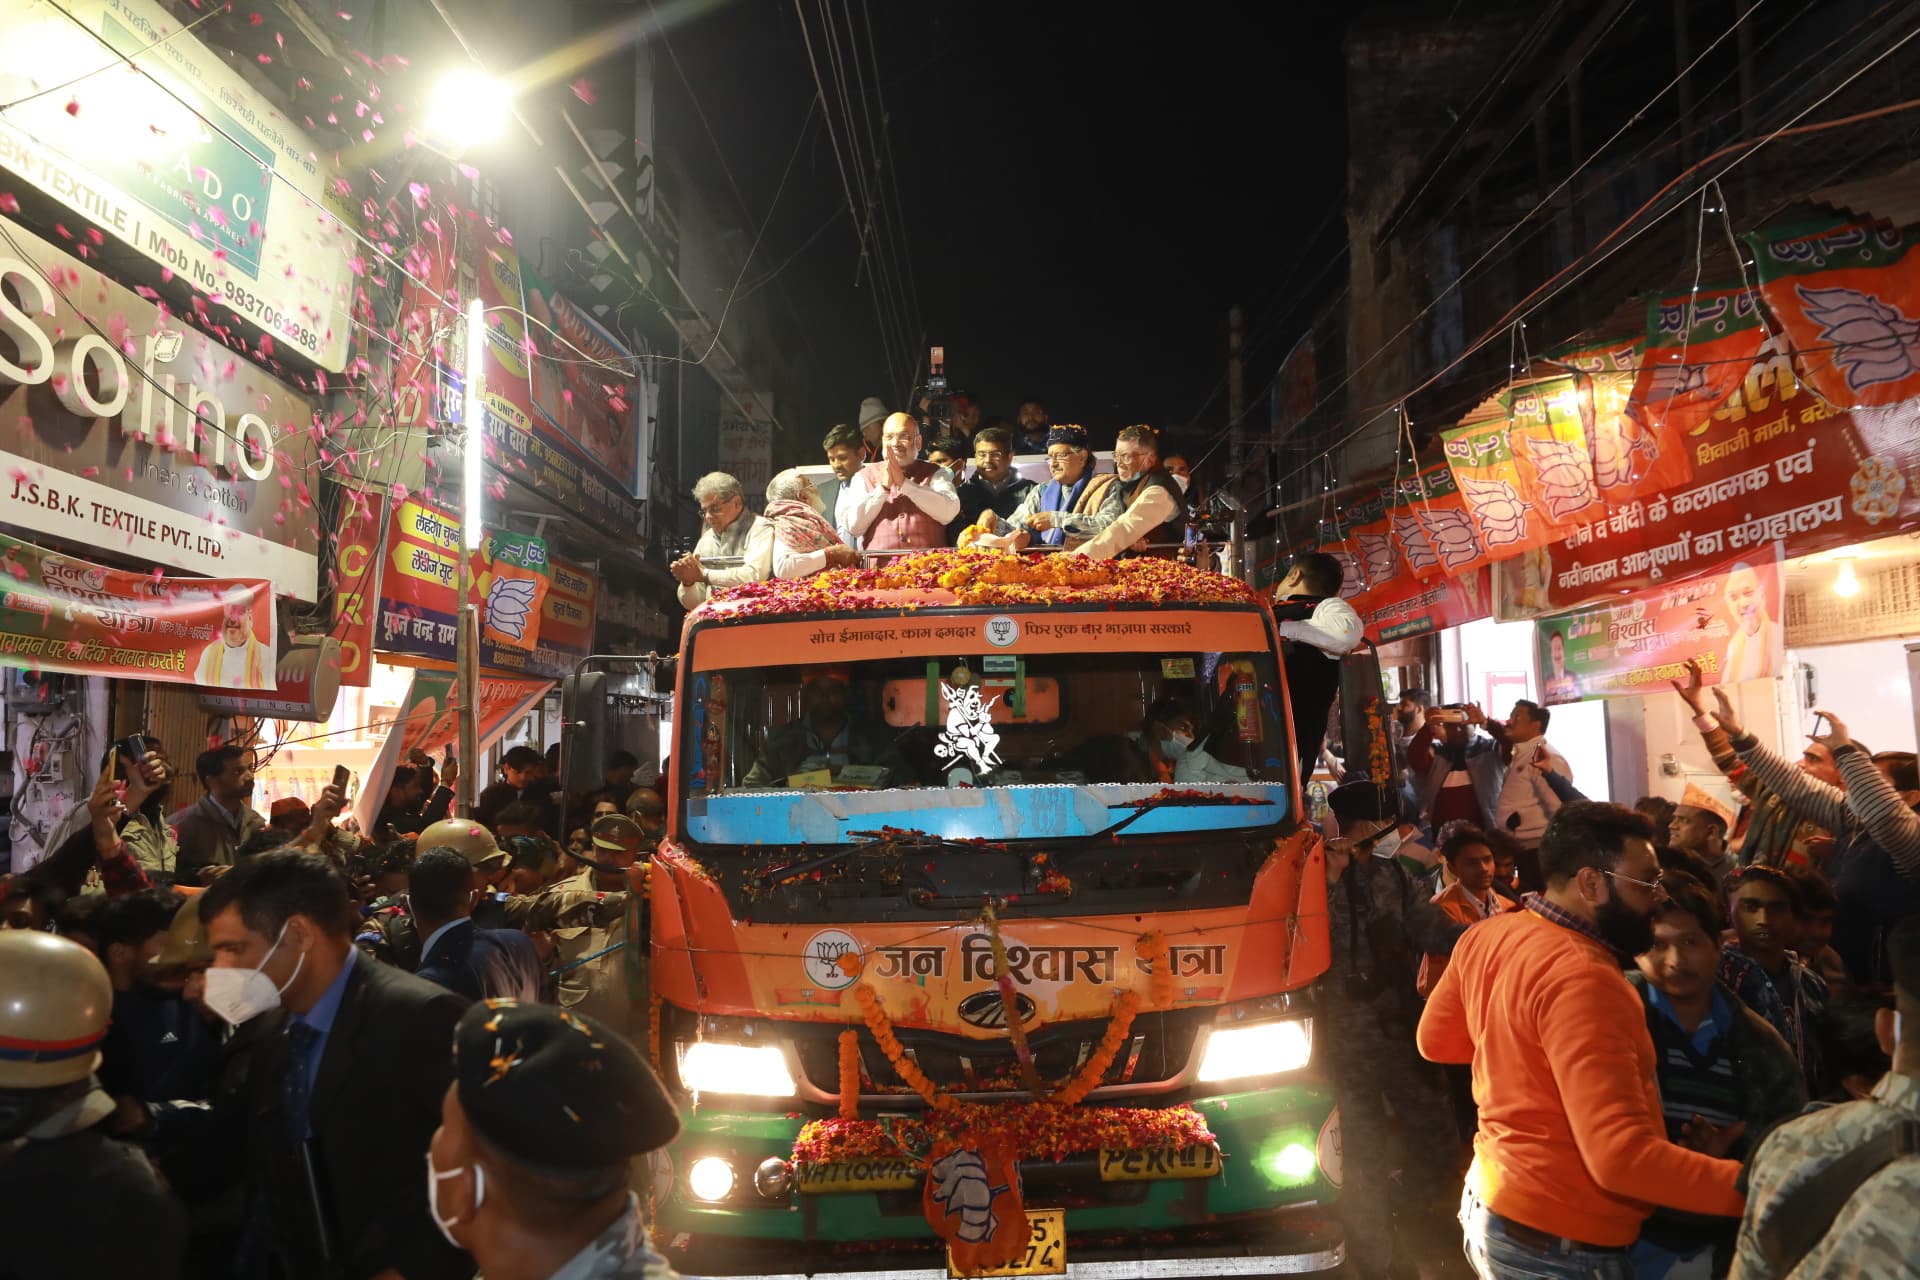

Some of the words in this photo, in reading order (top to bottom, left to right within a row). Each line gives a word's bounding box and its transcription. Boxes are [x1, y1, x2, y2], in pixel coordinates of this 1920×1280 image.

[42, 159, 127, 232] TEXTILE
[149, 230, 188, 270] Mob
[193, 260, 219, 292] No.
[0, 258, 274, 480] Solino
[497, 402, 514, 419] UNIT
[515, 413, 526, 425] OF
[1697, 427, 1750, 466] शिवाजी
[140, 458, 181, 490] linen
[186, 475, 198, 496] &
[203, 482, 249, 514] cotton
[1595, 519, 1607, 539] व
[1610, 501, 1646, 534] चाँदी
[1648, 493, 1668, 522] के
[1671, 463, 1770, 514] कलात्मक
[1775, 437, 1817, 483] एवं
[10, 478, 84, 518] J.S.B.K.
[91, 502, 157, 540] TEXTILE
[161, 524, 192, 550] PVT.
[197, 536, 225, 559] LTD.
[415, 511, 442, 538] लहंगा
[1557, 558, 1618, 589] नवीनतम
[1621, 531, 1692, 579] आभूषणों
[1693, 529, 1723, 556] का
[1727, 495, 1844, 549] संग्रहालय
[43, 562, 81, 581] जन
[440, 562, 453, 585] सूट
[96, 609, 156, 633] यात्रा
[438, 623, 457, 645] राम
[810, 629, 835, 644] सोच
[901, 627, 931, 639] काम
[935, 626, 976, 638] दमदार
[1025, 621, 1050, 635] फिर
[1054, 624, 1078, 638] एक
[1081, 624, 1102, 635] बार
[1105, 623, 1146, 635] भाजपा
[1607, 618, 1656, 642] विश्वास
[48, 639, 67, 658] पर
[109, 648, 148, 668] स्वागत
[149, 649, 174, 670] करते
[177, 649, 186, 673] हैं
[875, 946, 947, 977] जन
[961, 933, 1119, 984] विश्वास
